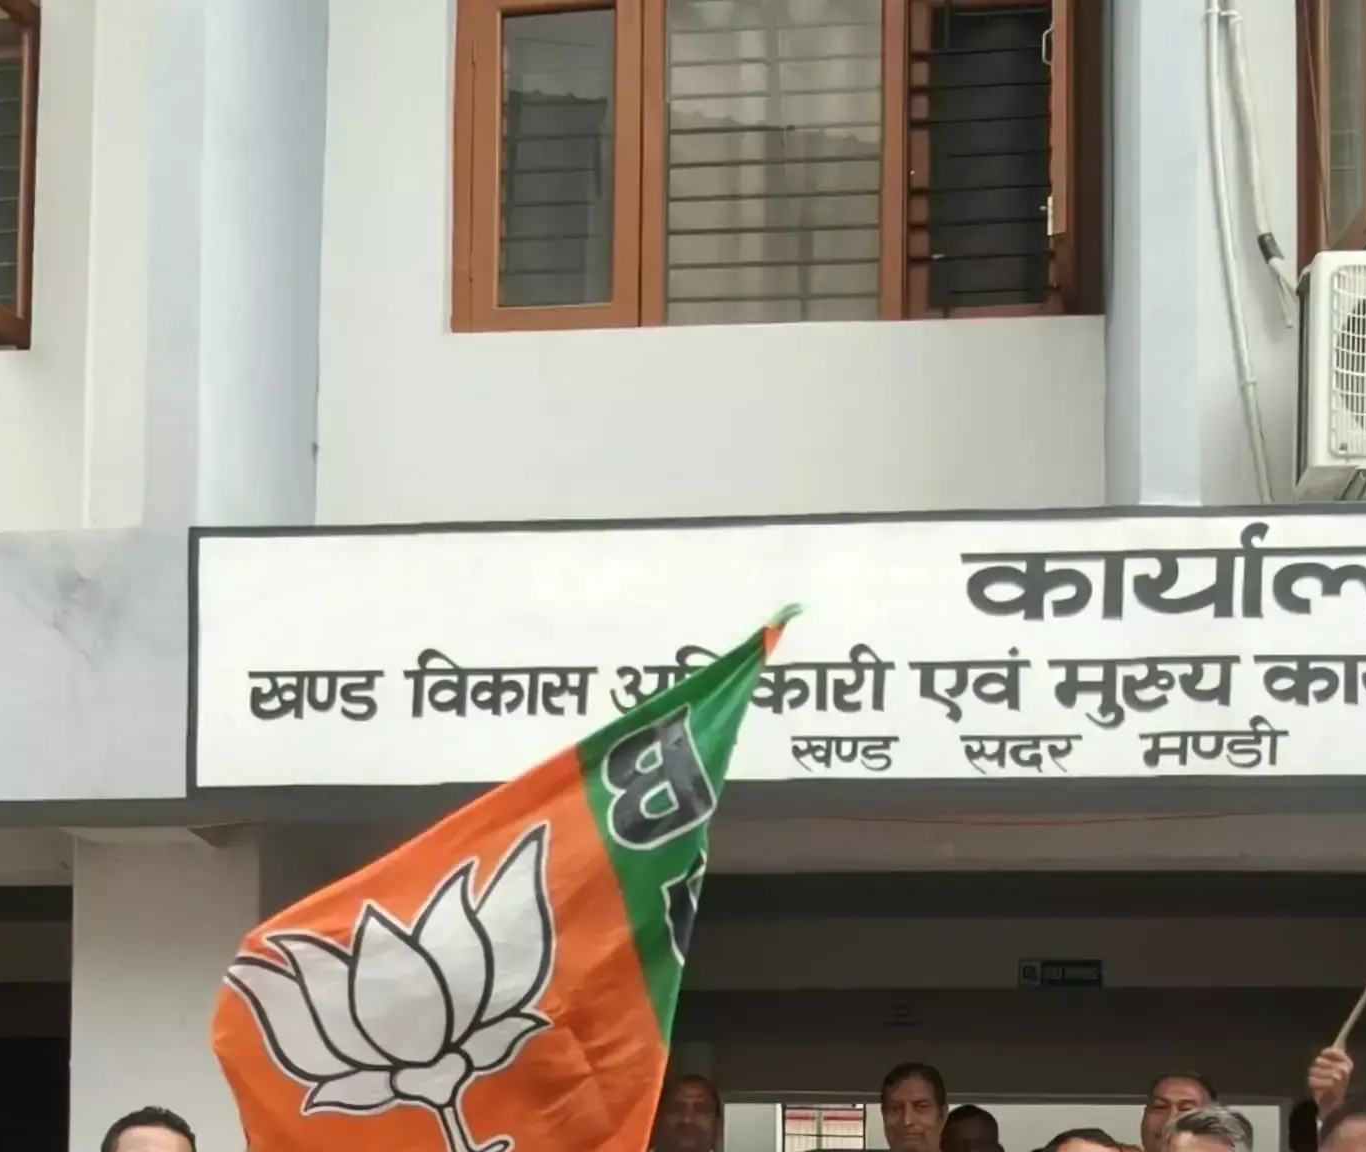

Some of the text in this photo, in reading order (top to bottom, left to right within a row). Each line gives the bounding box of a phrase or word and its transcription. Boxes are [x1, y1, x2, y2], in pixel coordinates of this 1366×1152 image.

[248, 669, 384, 721] खण्ड
[404, 647, 598, 719] विकास
[908, 647, 1031, 723] एवं
[1047, 654, 1240, 729] मुख्य
[791, 736, 900, 772] खण्ड
[960, 734, 1083, 774] सदर
[1139, 714, 1289, 768] मण्डी
